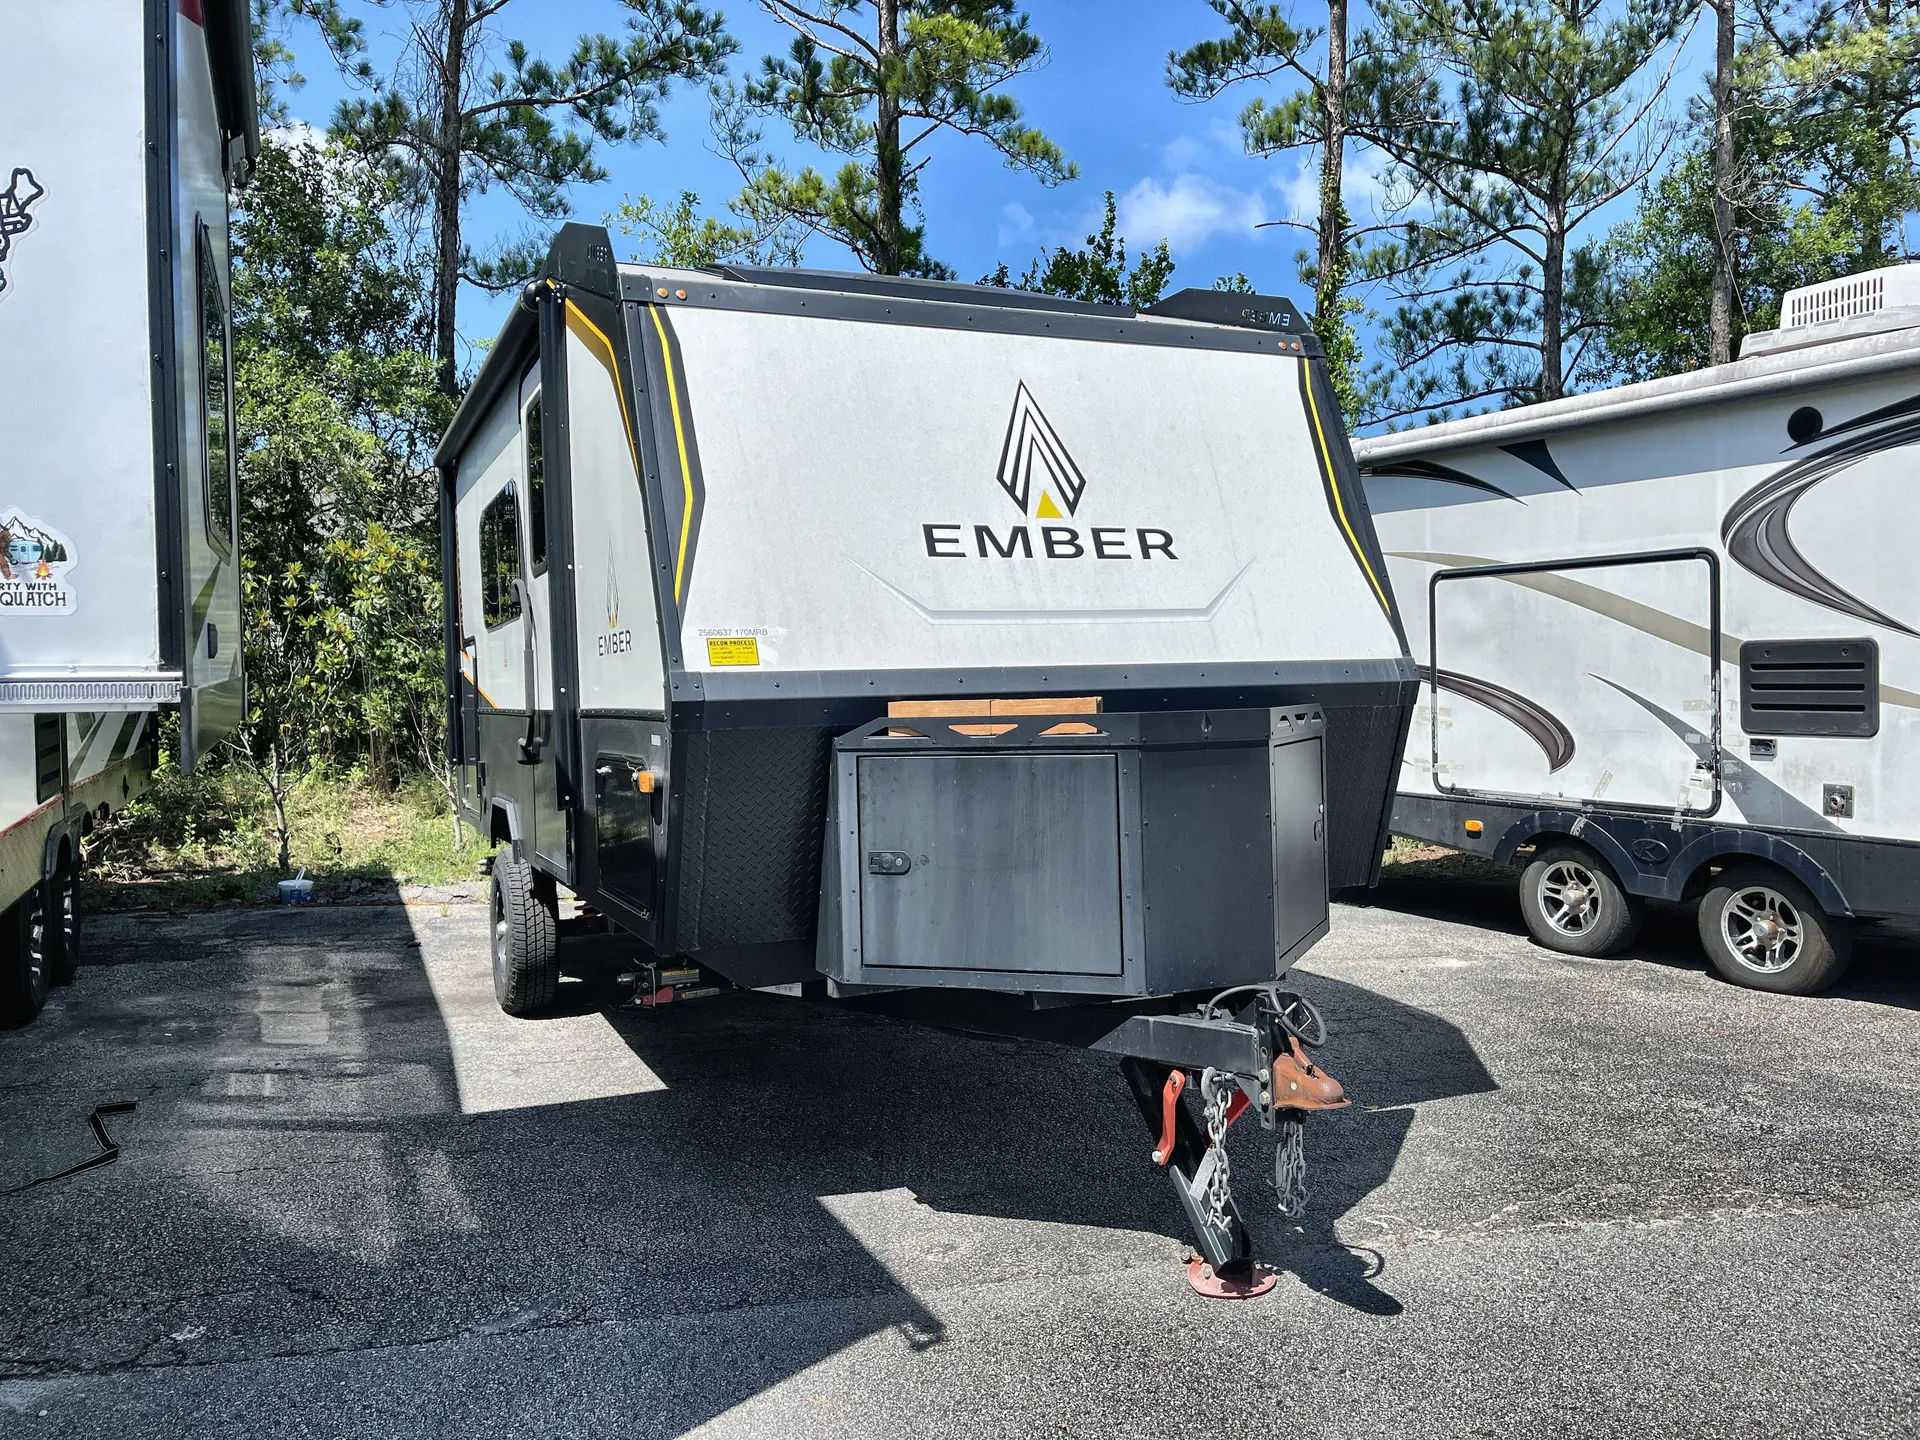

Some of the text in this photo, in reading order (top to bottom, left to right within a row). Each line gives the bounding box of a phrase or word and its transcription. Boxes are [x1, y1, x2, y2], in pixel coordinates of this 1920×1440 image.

[922, 523, 1179, 560] EMBER
[25, 582, 57, 591] WITH
[0, 591, 66, 607] QUATCH
[698, 628, 769, 637] 2560637 170MRB
[598, 629, 632, 657] EMBER
